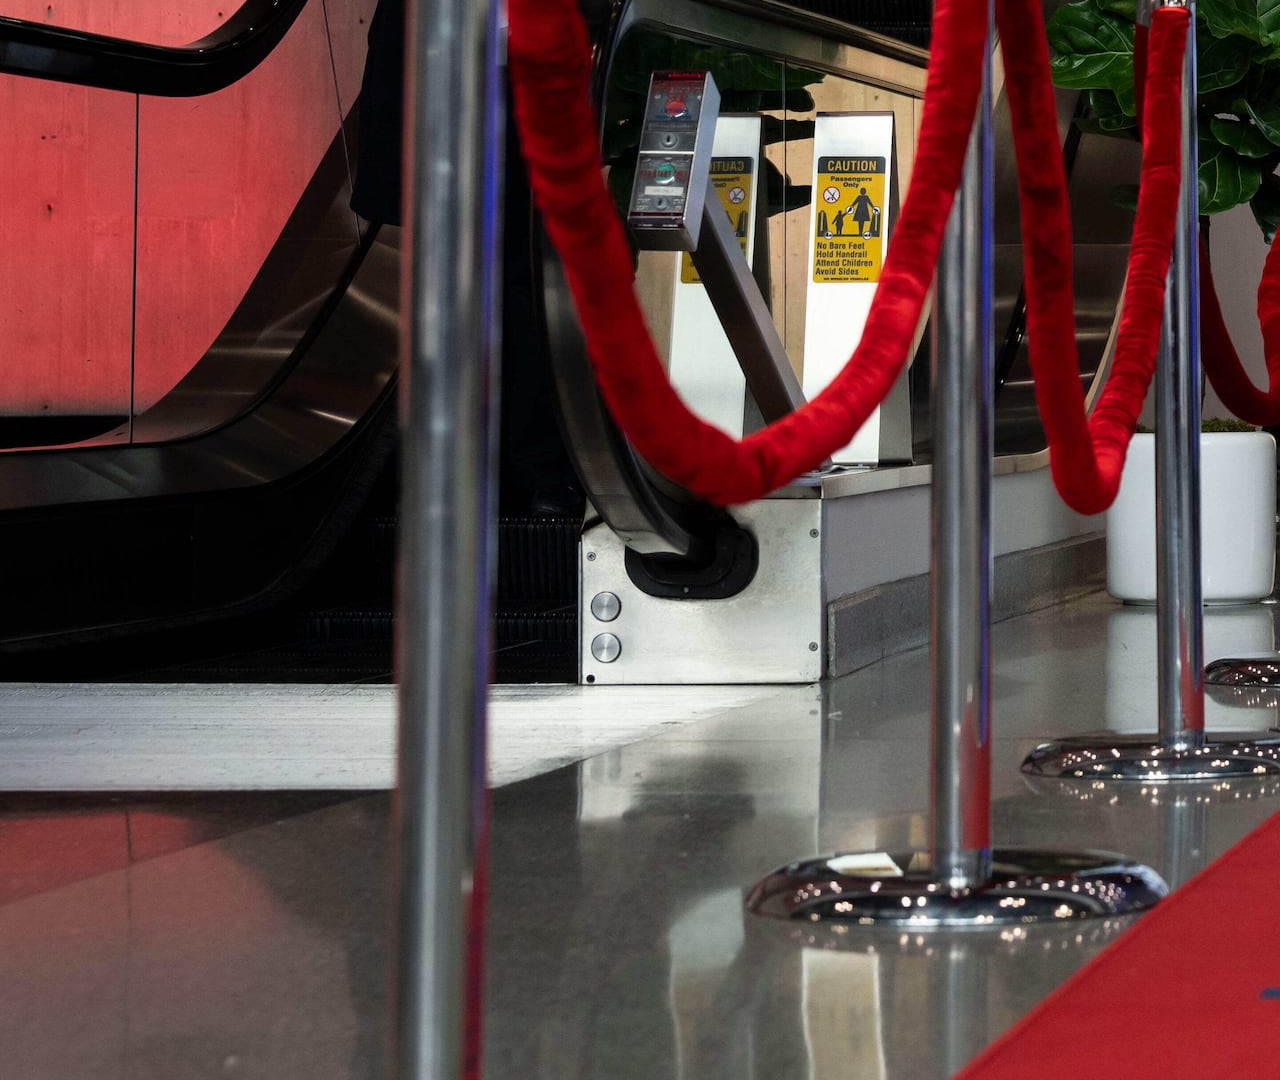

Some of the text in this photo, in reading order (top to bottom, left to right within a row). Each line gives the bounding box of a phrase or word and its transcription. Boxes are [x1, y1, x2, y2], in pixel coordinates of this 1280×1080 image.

[827, 160, 877, 172] CAUTION
[816, 259, 873, 267] Attend Children
